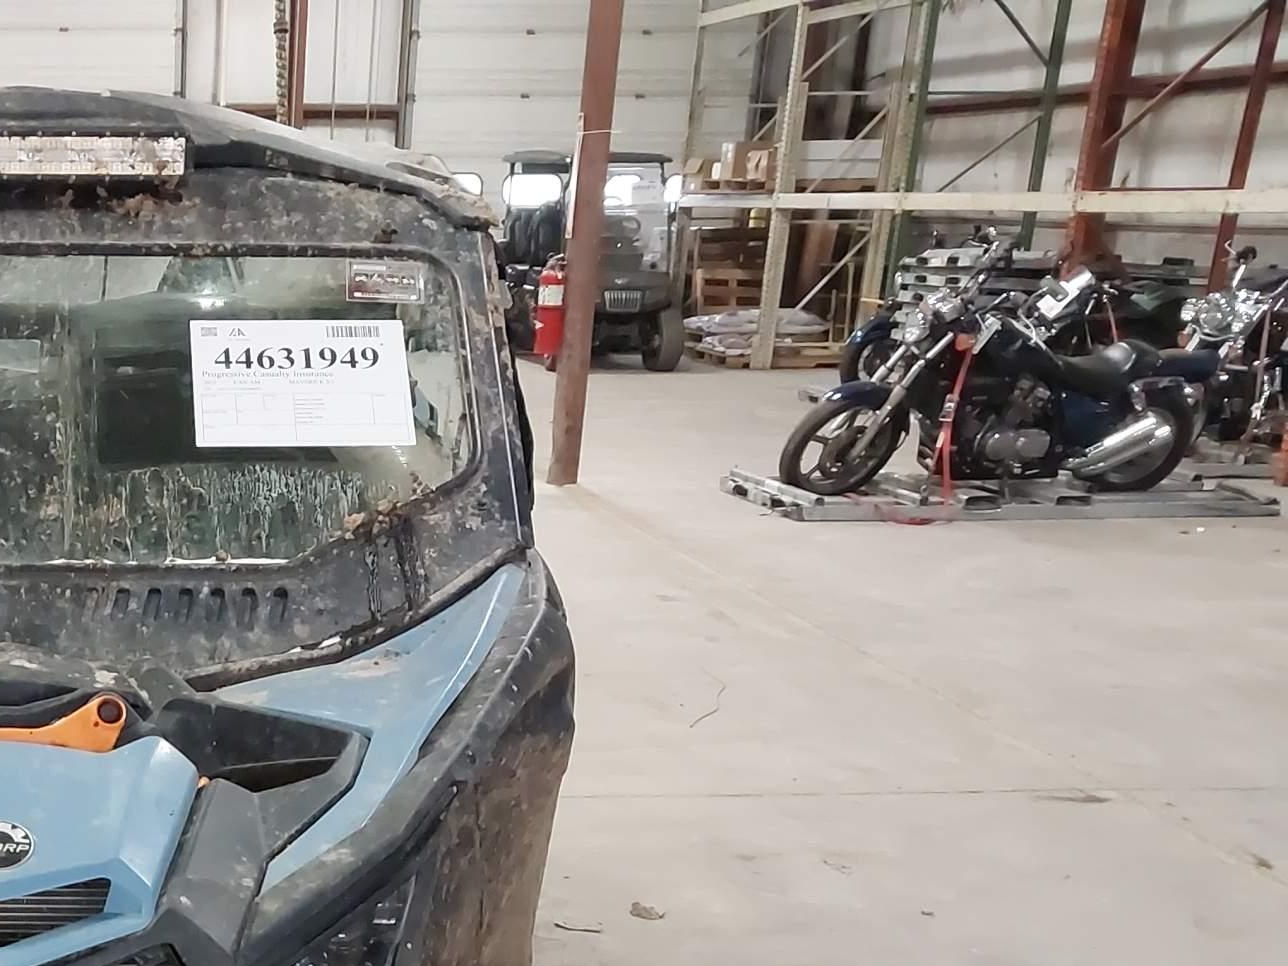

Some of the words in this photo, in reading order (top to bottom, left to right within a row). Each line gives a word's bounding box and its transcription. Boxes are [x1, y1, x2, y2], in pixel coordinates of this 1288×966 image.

[214, 347, 379, 369] 44631949
[202, 370, 252, 379] Progressive
[253, 370, 289, 379] Casualty
[294, 370, 334, 378] Insurance
